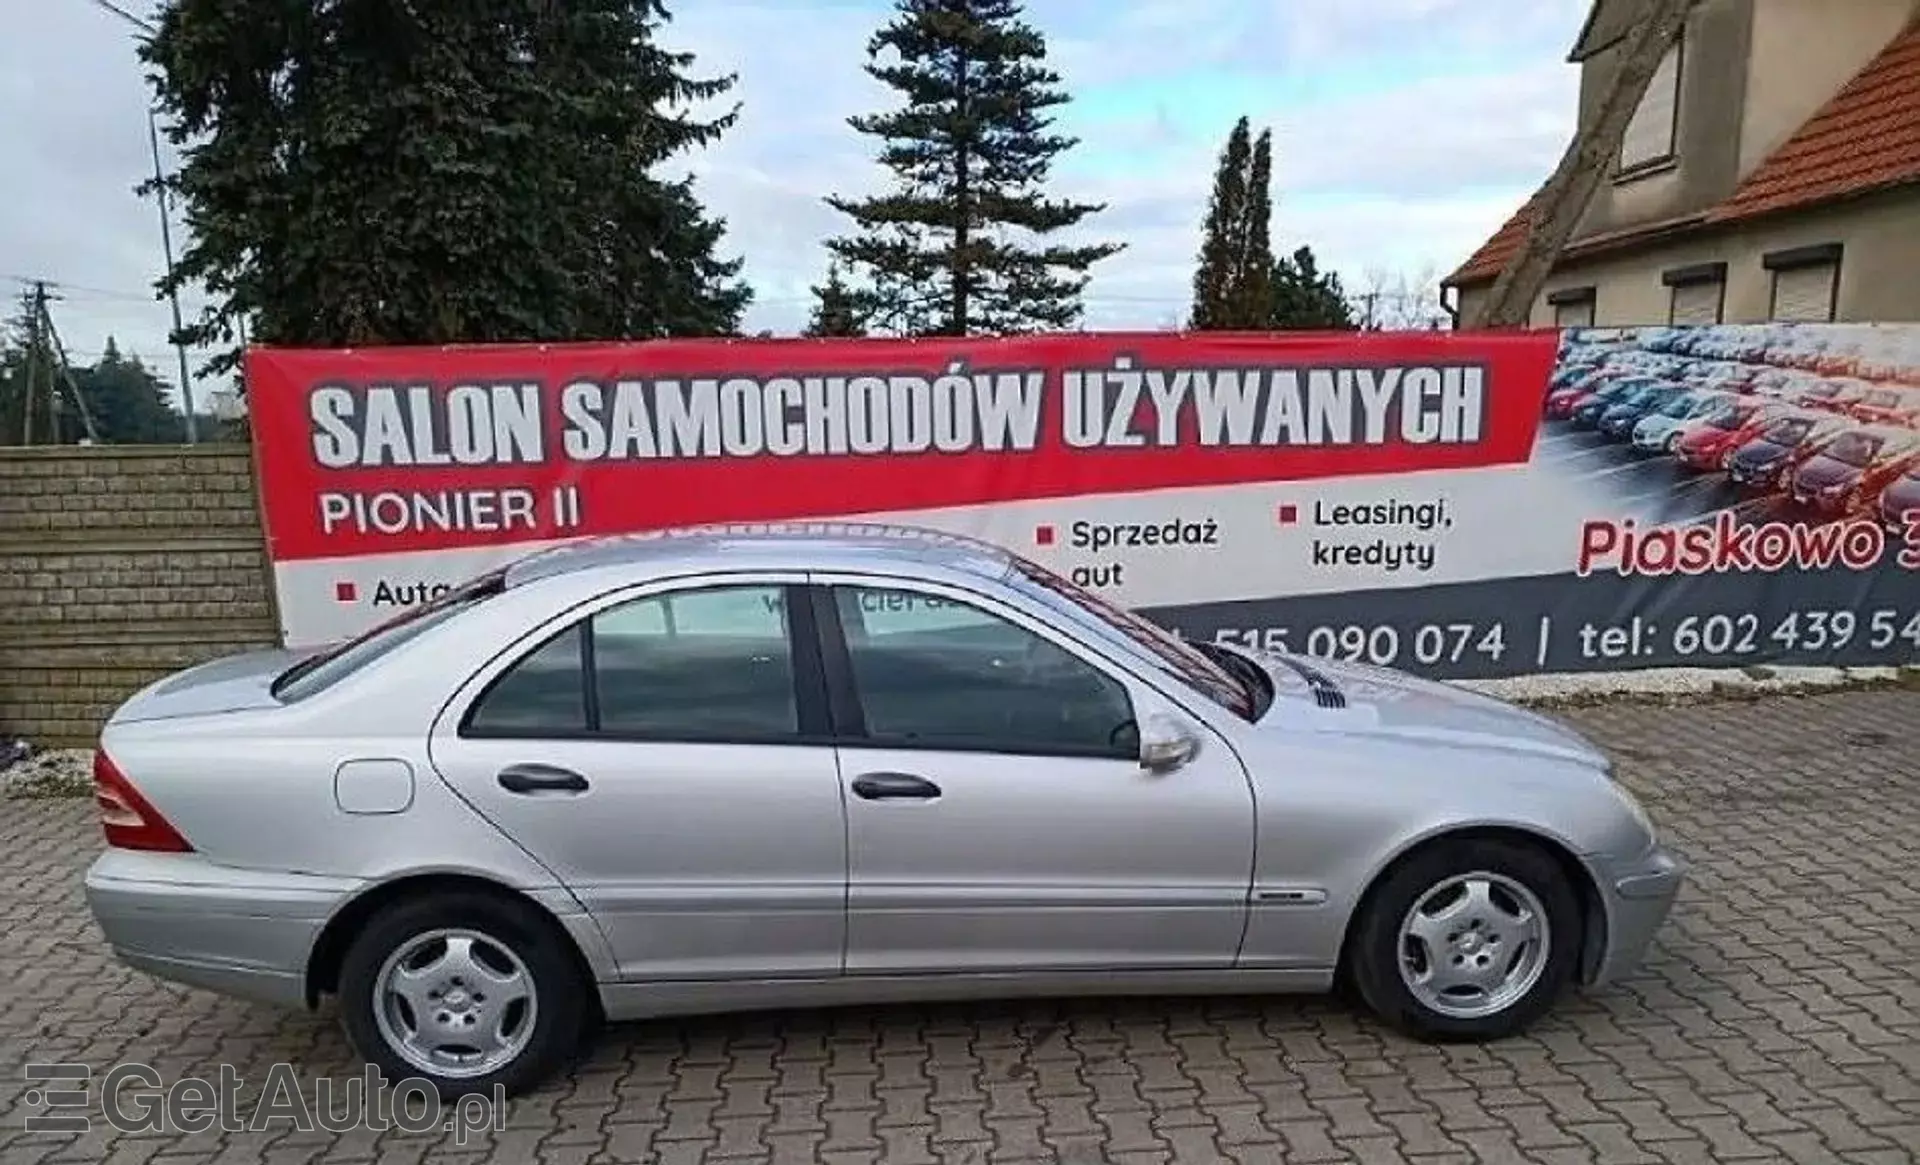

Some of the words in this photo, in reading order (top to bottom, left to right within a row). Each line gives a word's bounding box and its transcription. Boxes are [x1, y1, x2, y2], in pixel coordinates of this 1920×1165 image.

[311, 383, 545, 468] SALON
[563, 361, 1046, 460] SAMOCHODÓW
[1062, 356, 1484, 448] UŻYWANYCH
[320, 489, 536, 534] PIONIER
[554, 487, 579, 527] II
[1314, 499, 1452, 529] Leasingi,
[1071, 518, 1218, 553] Sprzedaż
[1313, 539, 1435, 571] kredyty
[1577, 510, 1885, 577] Piaskowo
[1071, 563, 1123, 588] aut
[1307, 626, 1398, 666] 090
[1415, 624, 1506, 664] 074
[1579, 616, 1657, 658] tel:
[1672, 613, 1759, 656] 602
[1771, 609, 1856, 651] 439
